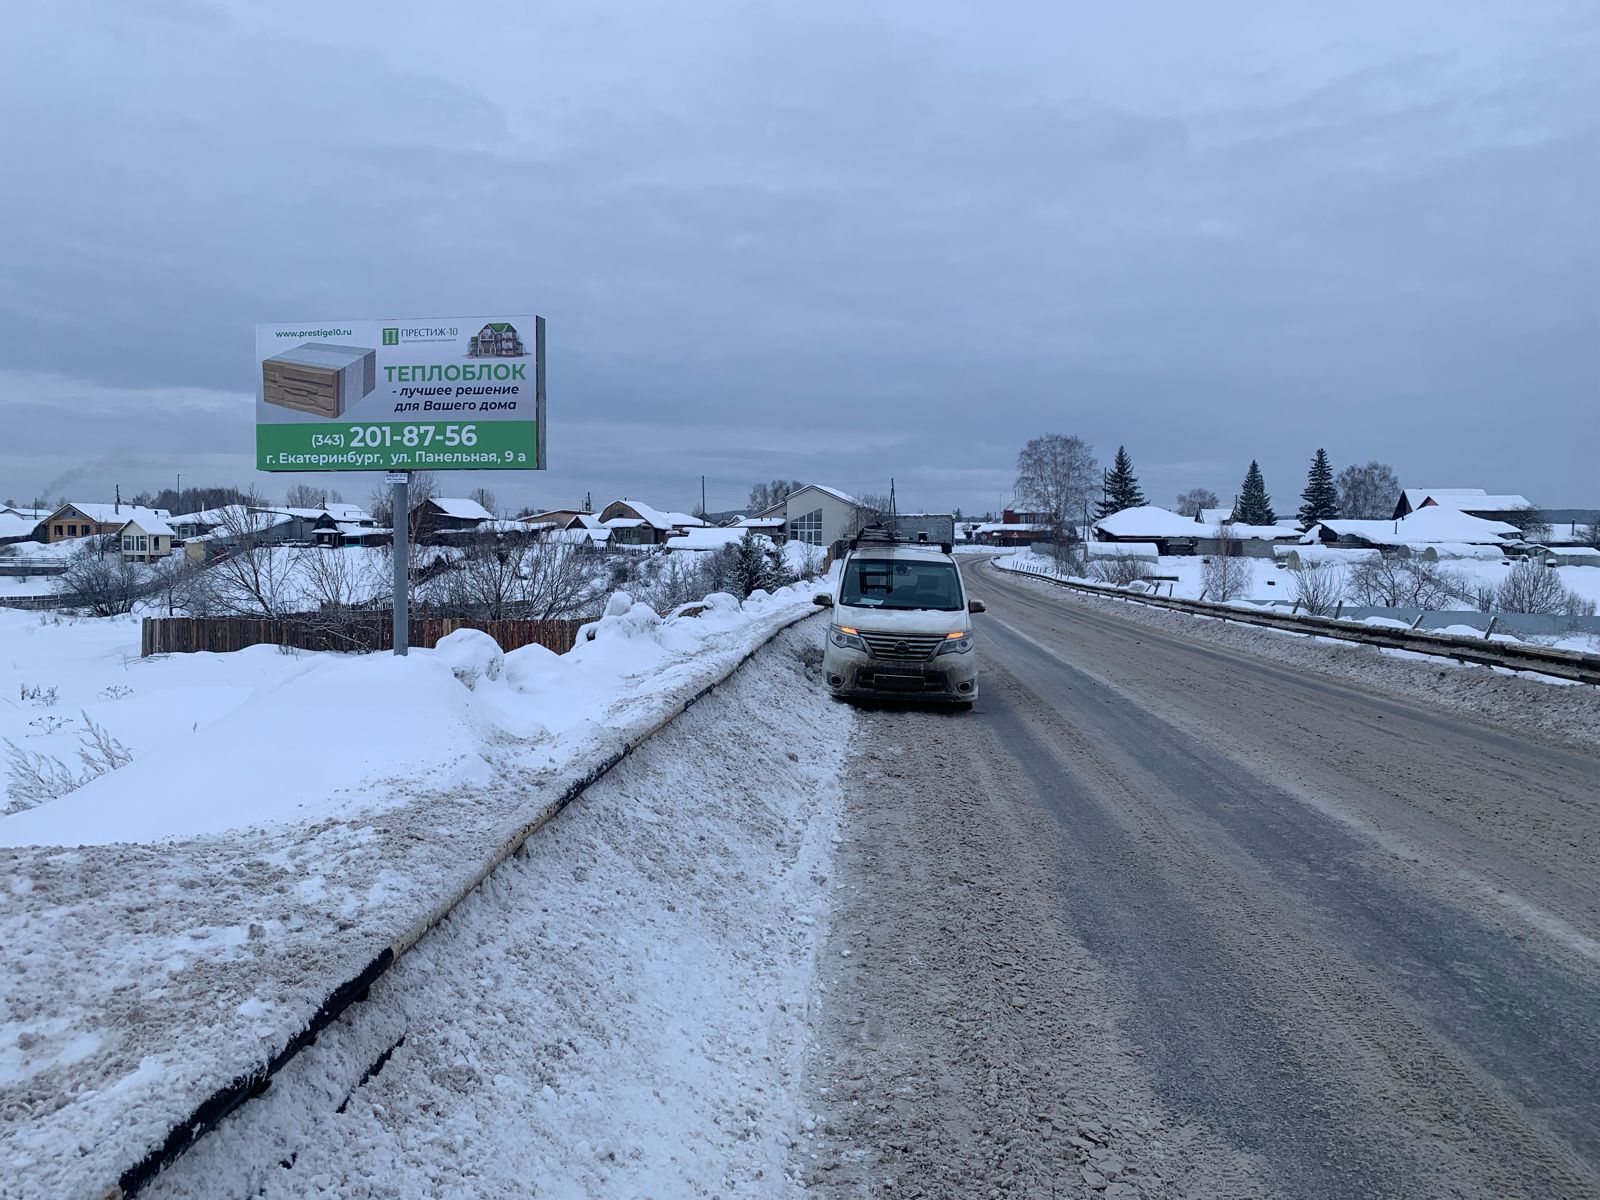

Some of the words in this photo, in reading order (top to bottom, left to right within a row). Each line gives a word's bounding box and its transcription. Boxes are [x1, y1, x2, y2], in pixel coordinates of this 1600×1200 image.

[275, 328, 352, 338] www.prestige10.ru
[384, 363, 526, 382] ТЕПЛОБЛОК
[400, 386, 453, 398] лучшее
[456, 385, 520, 397] решение
[394, 401, 420, 413] для
[423, 400, 477, 411] Вашего
[479, 400, 517, 411] дома
[311, 433, 345, 448] (343)
[349, 425, 478, 448] 201-87-56
[266, 454, 276, 464] г.
[279, 451, 383, 466] Екатеринбург,
[391, 453, 411, 465] ул.
[415, 450, 501, 464] Панельная,
[504, 450, 514, 462] 9
[517, 452, 527, 462] а
